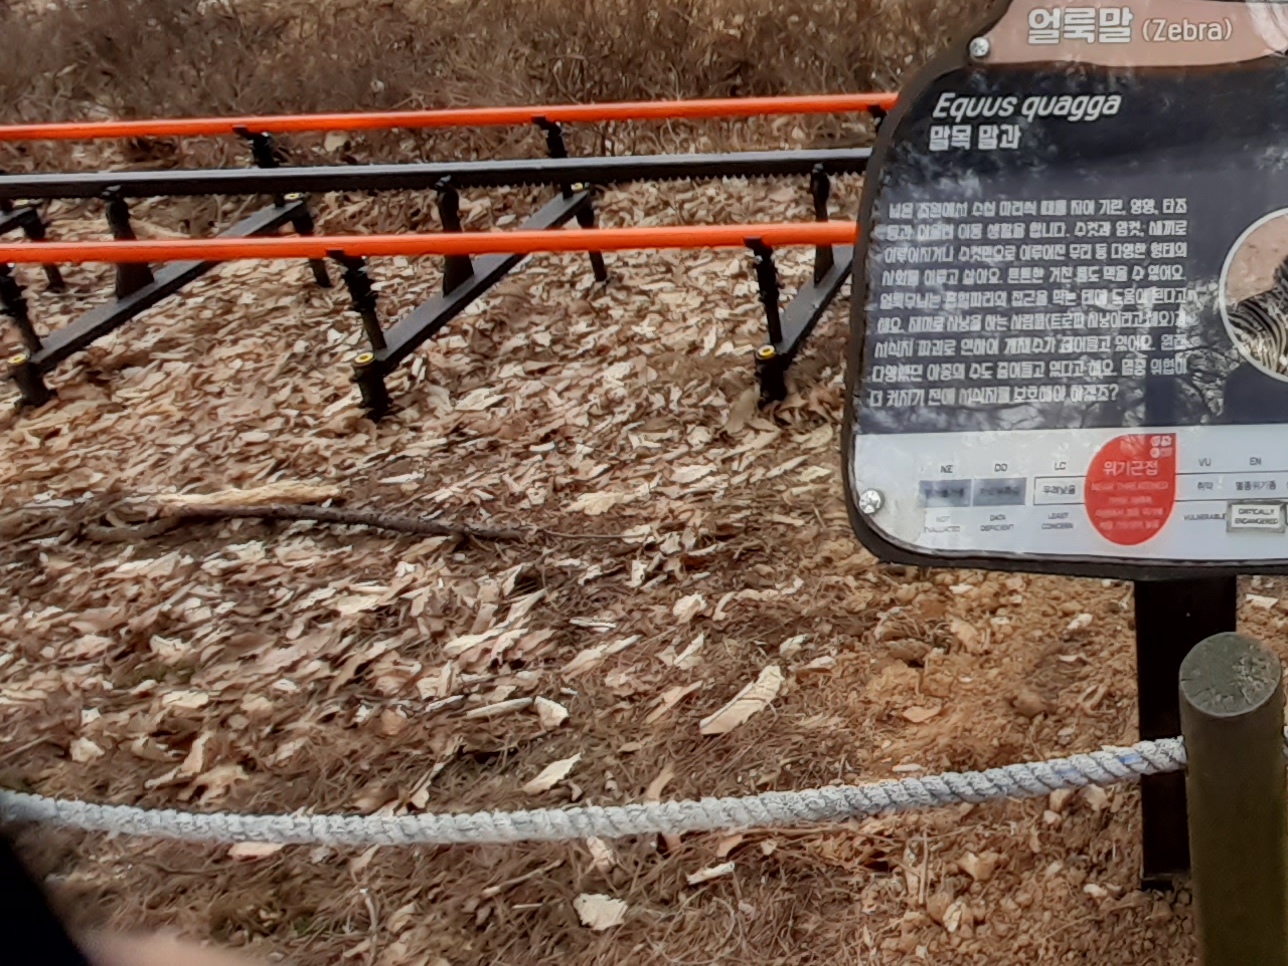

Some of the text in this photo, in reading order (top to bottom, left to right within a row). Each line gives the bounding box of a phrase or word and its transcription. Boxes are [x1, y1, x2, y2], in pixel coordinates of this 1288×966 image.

[1027, 6, 1233, 45] 얼룩말 (Zebra)
[932, 92, 1122, 123] Equus quagga
[929, 124, 1022, 151] 말목 말과
[999, 201, 1037, 216] 마리씩
[1070, 199, 1095, 215] 지어
[1099, 199, 1127, 216] 기린,
[1130, 198, 1159, 215] 영양,
[1162, 198, 1187, 214] 타조
[958, 223, 982, 240] 이동
[986, 222, 1026, 240] 생활을
[1029, 221, 1070, 238] 합니다.
[1074, 221, 1111, 237] 수컷과
[1116, 220, 1145, 237] 암컷,
[1149, 220, 1187, 236] 새끼로
[884, 241, 1187, 263] 이루어지거나 수컷만으로 이루어진 무리 등 다양한 형태의
[882, 269, 919, 286] 사회를
[924, 268, 959, 285] 이루고
[962, 268, 1003, 285] 살아요.
[1049, 266, 1073, 283] 거친
[1103, 265, 1128, 282] 먹을
[1132, 265, 1145, 281] 수
[1011, 289, 1048, 307] 접근을
[1052, 289, 1077, 306] 막는
[877, 317, 905, 334] 해요.
[908, 316, 946, 332] 재미로
[947, 314, 982, 332] 사냥을
[985, 313, 1009, 331] 하는
[1087, 310, 1143, 328] 사냥이라고
[874, 340, 914, 358] 서식지
[917, 339, 956, 356] 파괴로
[960, 338, 999, 355] 인하여
[927, 363, 965, 381] 아종의
[969, 362, 994, 380] 수도
[997, 360, 1045, 379] 줄어들고
[1049, 360, 1085, 377] 있다고
[1087, 359, 1117, 377] 해요.
[1121, 358, 1146, 376] 멸종
[1151, 357, 1188, 375] 위협이
[869, 383, 1119, 407] 더 커지기 전에 서식지를 보호해야 하겠죠?
[1054, 461, 1067, 471] LC
[1199, 457, 1212, 467] VU
[1249, 457, 1262, 466] EN
